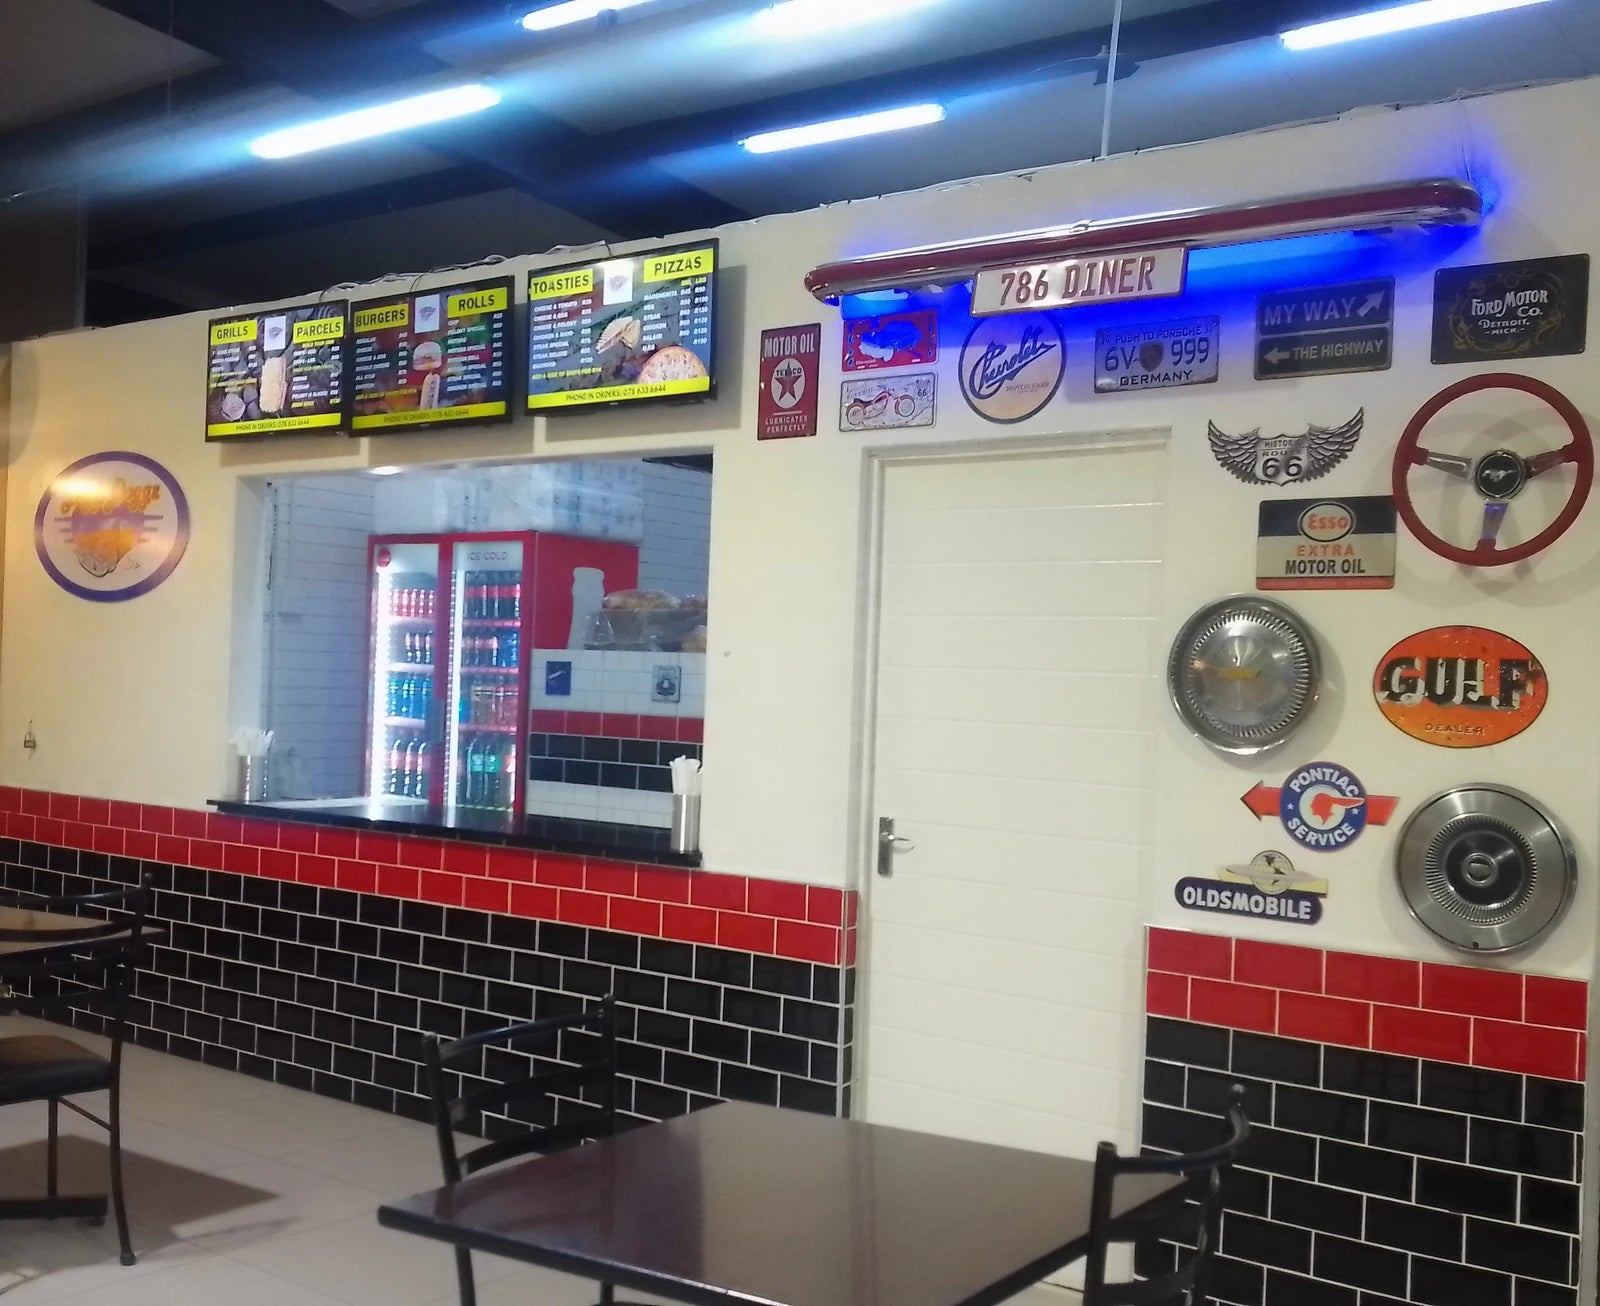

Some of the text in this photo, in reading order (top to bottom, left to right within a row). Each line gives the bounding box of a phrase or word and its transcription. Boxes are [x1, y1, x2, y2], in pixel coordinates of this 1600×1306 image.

[654, 256, 702, 276] PIZZAS
[533, 275, 589, 295] TOASTIES
[1000, 256, 1156, 306] 786 DINER
[458, 294, 495, 311] ROLLS
[1264, 297, 1356, 326] MY WAY
[355, 309, 406, 327] BURGERS
[216, 326, 249, 339] GRILLS
[296, 322, 341, 337] PARCELS
[1116, 327, 1201, 344] PUSH TO PORSCHE
[764, 332, 815, 358] MOTOR OIL
[1171, 337, 1209, 366] 999
[1292, 339, 1383, 361] THE HIGHWAY
[969, 325, 1056, 400] Chevrolet
[1120, 370, 1193, 386] GERMANY
[566, 392, 586, 401] PHONE
[587, 391, 594, 399] IN
[650, 385, 666, 393] 6644
[917, 389, 927, 397] 66
[765, 415, 808, 425] LUBRICATES
[766, 424, 805, 433] PERFECTLY
[1262, 456, 1303, 479] 66
[1296, 544, 1355, 557] EXTRA
[1285, 558, 1366, 575] MOTOR OIL
[1380, 657, 1533, 710] GULF
[1424, 723, 1485, 736] DEALER
[1289, 767, 1359, 797] PONTIAC
[1287, 817, 1356, 846] SERVICE
[1182, 886, 1312, 921] OLDSMOBILE
